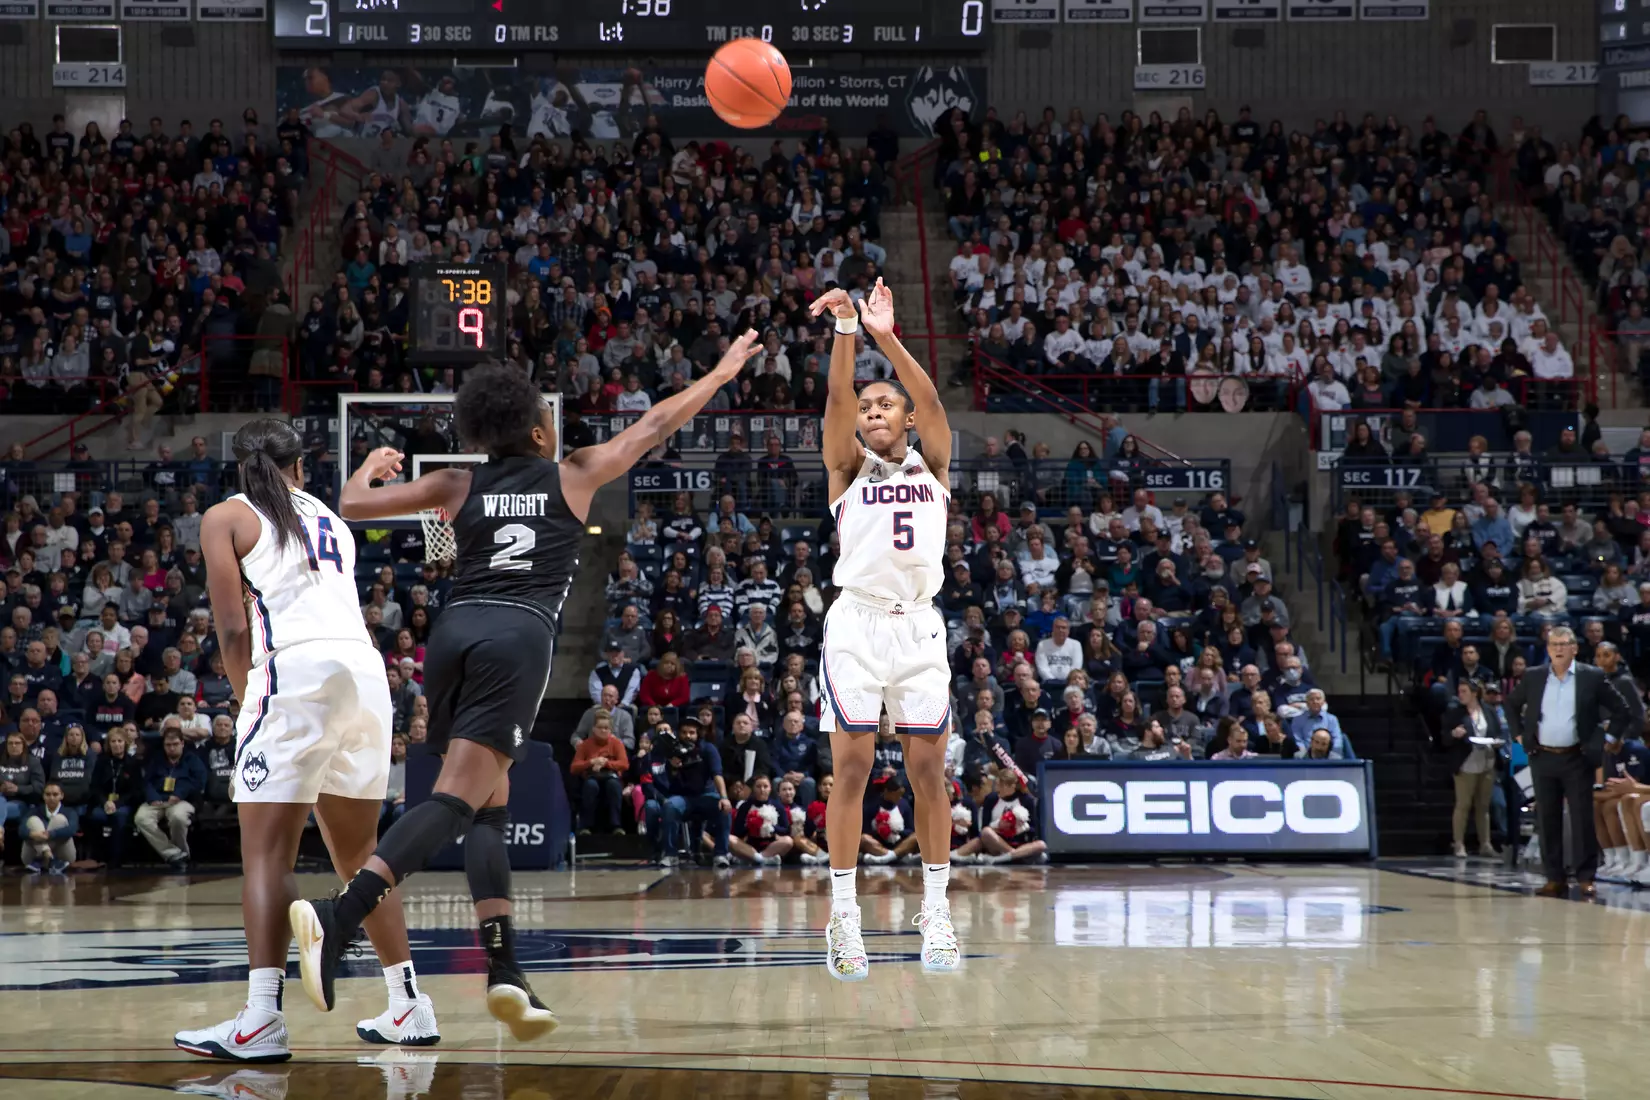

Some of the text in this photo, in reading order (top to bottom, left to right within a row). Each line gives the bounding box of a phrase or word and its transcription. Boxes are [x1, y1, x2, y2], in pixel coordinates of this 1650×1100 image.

[305, 1, 328, 35] 2
[962, 1, 983, 35] 0
[356, 25, 388, 41] FULL
[410, 24, 472, 43] 3 30 SEC
[495, 24, 559, 43] 0 TM FLS
[707, 25, 773, 43] TM FLS 0
[792, 25, 854, 42] 30 SEC 3
[874, 25, 921, 42] FULL 1
[55, 68, 124, 83] SEC 214
[654, 77, 692, 90] Harry
[839, 77, 884, 89] Storrs,
[888, 77, 907, 88] CT
[1136, 70, 1204, 85] SEC 216
[1532, 69, 1556, 79] SEC
[801, 95, 815, 107] of
[819, 95, 843, 107] the
[846, 95, 889, 107] World
[442, 280, 491, 304] 7:38
[459, 308, 483, 348] 9
[634, 471, 711, 489] SEC 116
[1146, 470, 1223, 488] SEC 116
[1343, 468, 1421, 486] SEC 117
[862, 484, 934, 505] UCONN
[482, 493, 548, 517] WRIGHT
[893, 511, 915, 551] 5
[297, 514, 344, 574] 14
[489, 523, 536, 571] 2
[1053, 780, 1361, 834] GEICO
[503, 823, 545, 845] ERS
